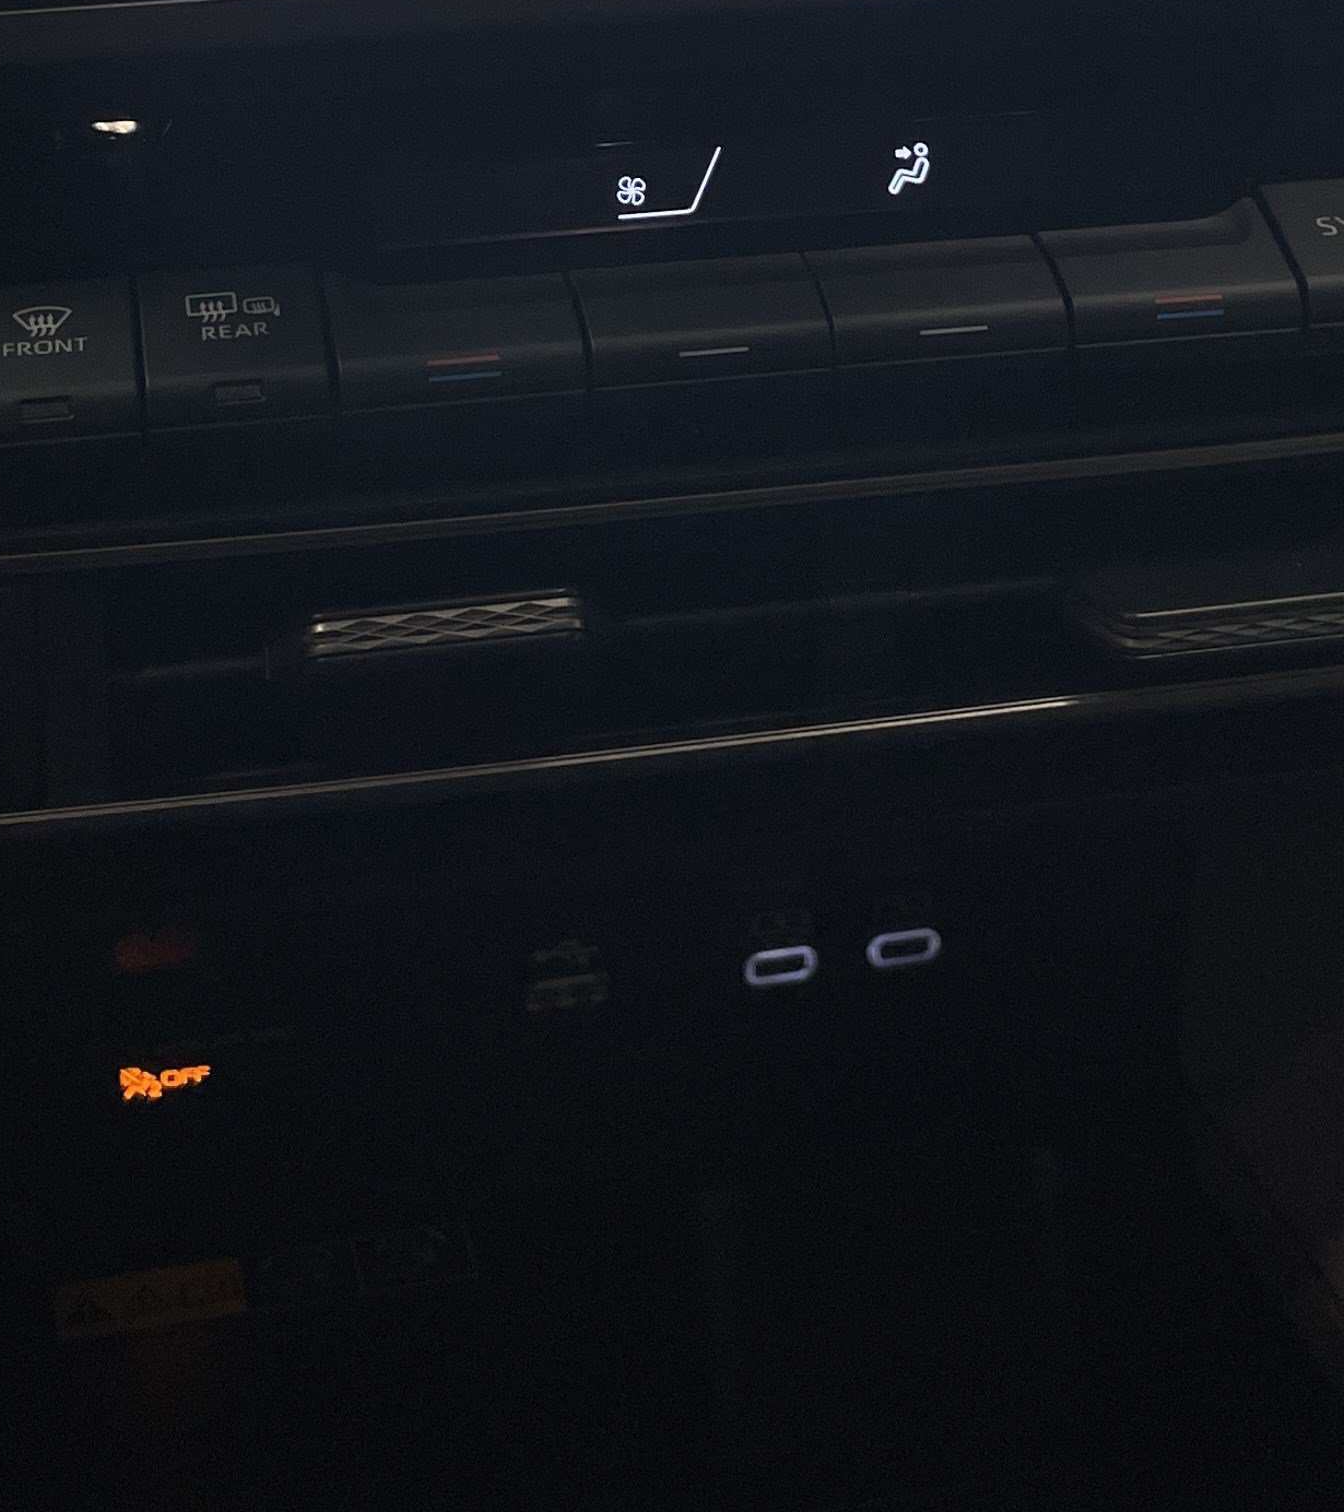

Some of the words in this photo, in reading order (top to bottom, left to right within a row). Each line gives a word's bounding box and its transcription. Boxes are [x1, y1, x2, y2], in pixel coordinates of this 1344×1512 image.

[200, 321, 270, 342] REAR
[1, 336, 88, 358] FRONT
[159, 1064, 212, 1088] OFF
